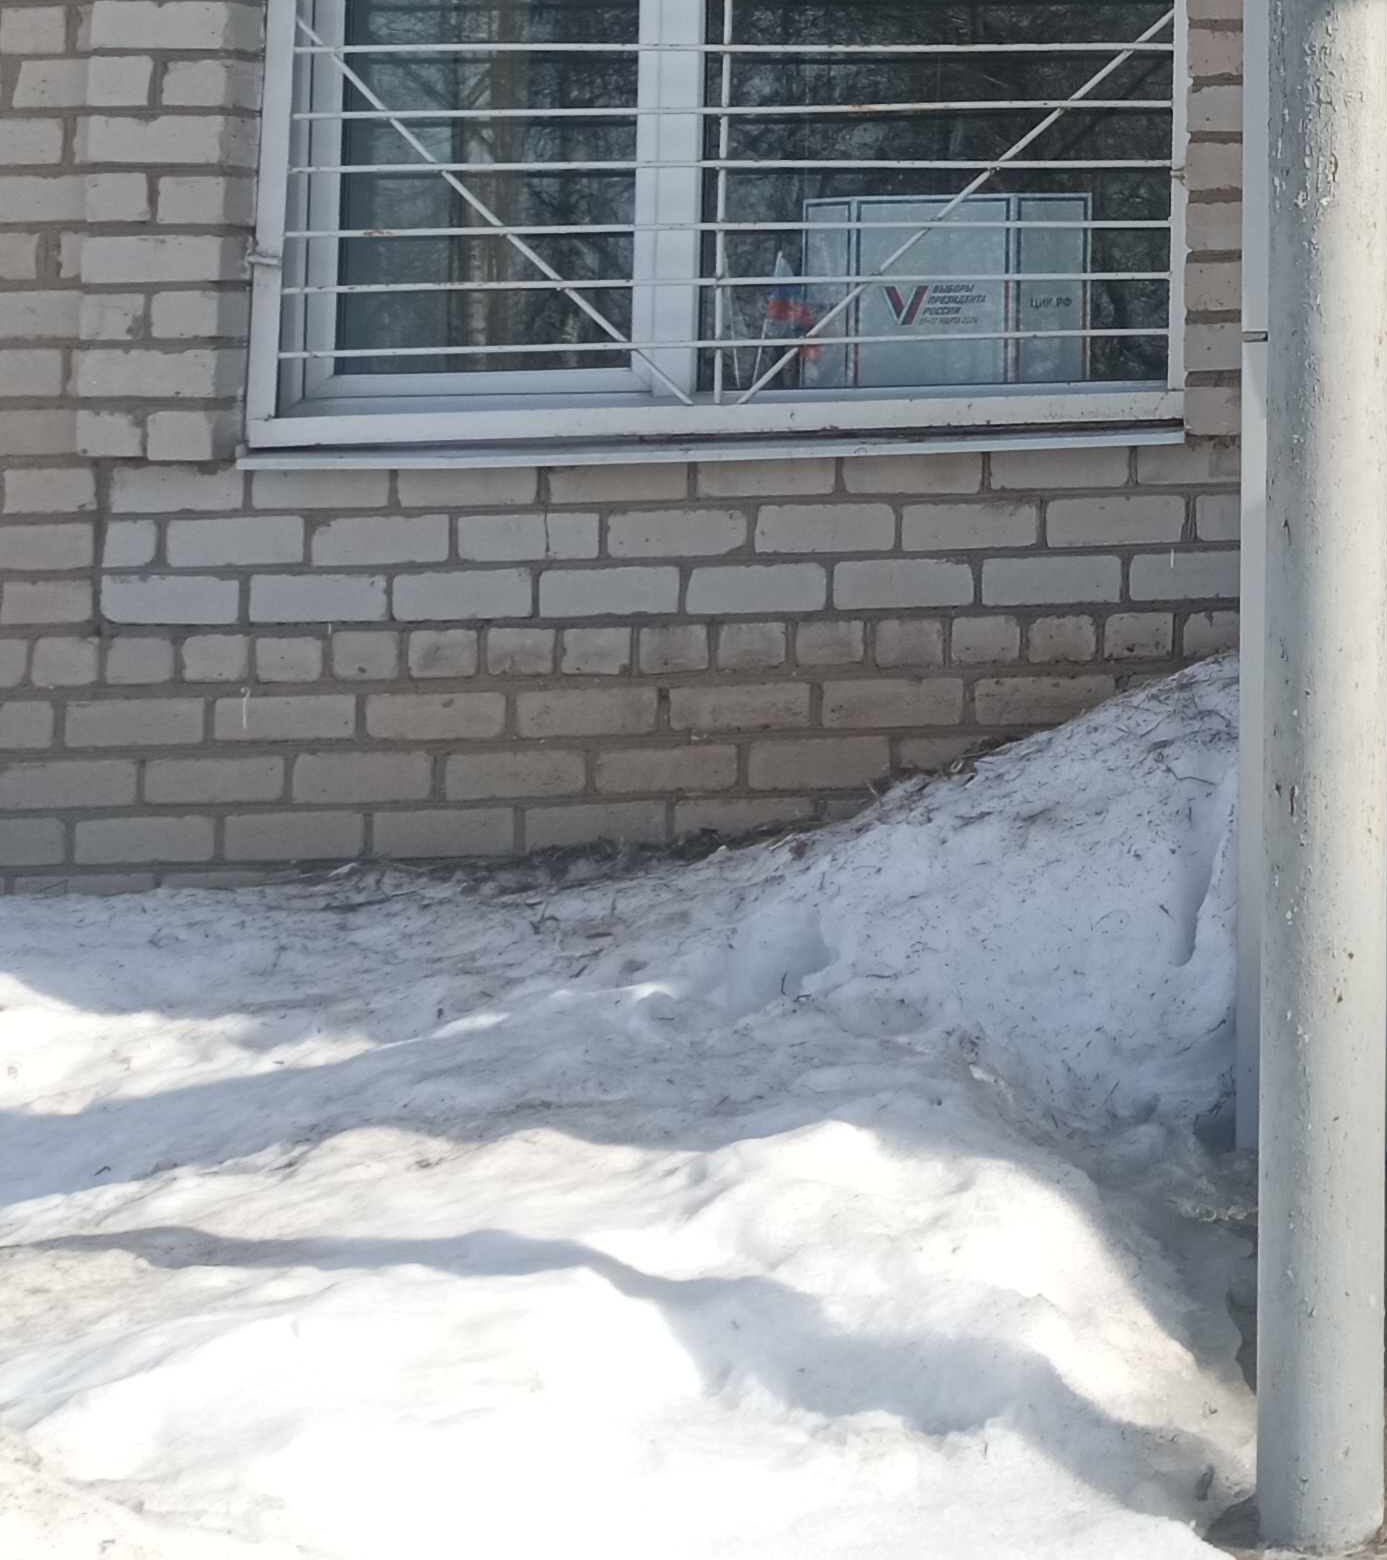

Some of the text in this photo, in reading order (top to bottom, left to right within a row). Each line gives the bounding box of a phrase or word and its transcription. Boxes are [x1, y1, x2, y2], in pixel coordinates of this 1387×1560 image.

[932, 284, 974, 294] ВЫБОРЫ
[927, 294, 986, 306] ПРЕЗИДЕНТА
[1030, 297, 1073, 310] ЦИК.РФ
[922, 306, 961, 316] РОССИИ
